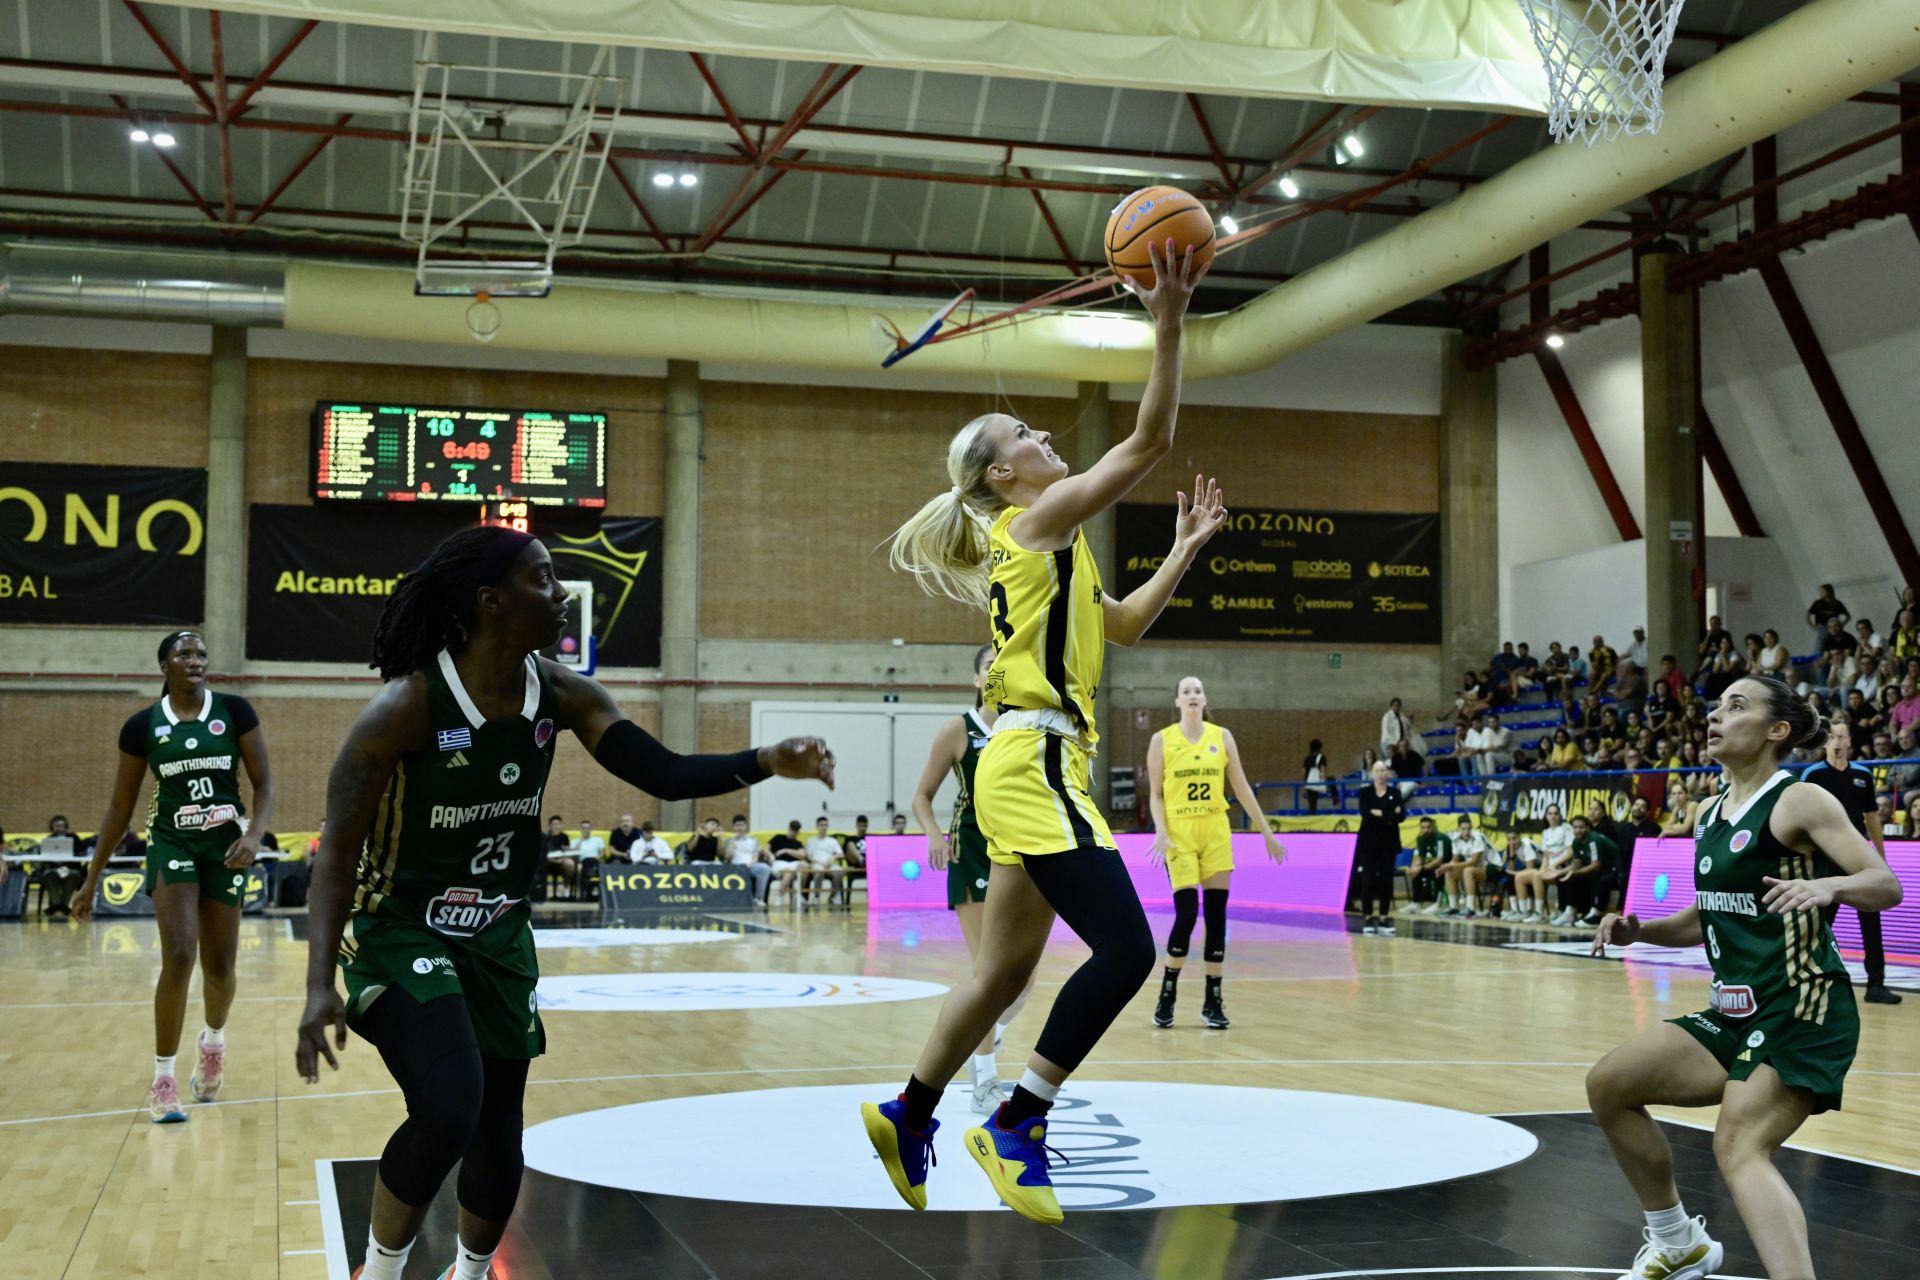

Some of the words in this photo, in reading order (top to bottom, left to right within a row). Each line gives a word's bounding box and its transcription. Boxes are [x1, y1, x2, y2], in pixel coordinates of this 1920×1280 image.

[427, 418, 455, 436] 10
[479, 420, 497, 438] 4
[1219, 513, 1335, 536] HOZONO
[1384, 564, 1430, 577] SOTECA
[275, 570, 404, 595] Alcantar
[1227, 597, 1275, 610] AMBEX
[1305, 600, 1354, 610] entorno
[159, 755, 232, 778] PANATHINAIKOS
[188, 776, 214, 801] 20
[1187, 783, 1211, 801] 22
[1529, 788, 1567, 821] ZONA
[471, 831, 516, 875] 23
[606, 873, 747, 891] HOZONO
[659, 894, 703, 903] GLOBAL
[1707, 924, 1720, 959] 8
